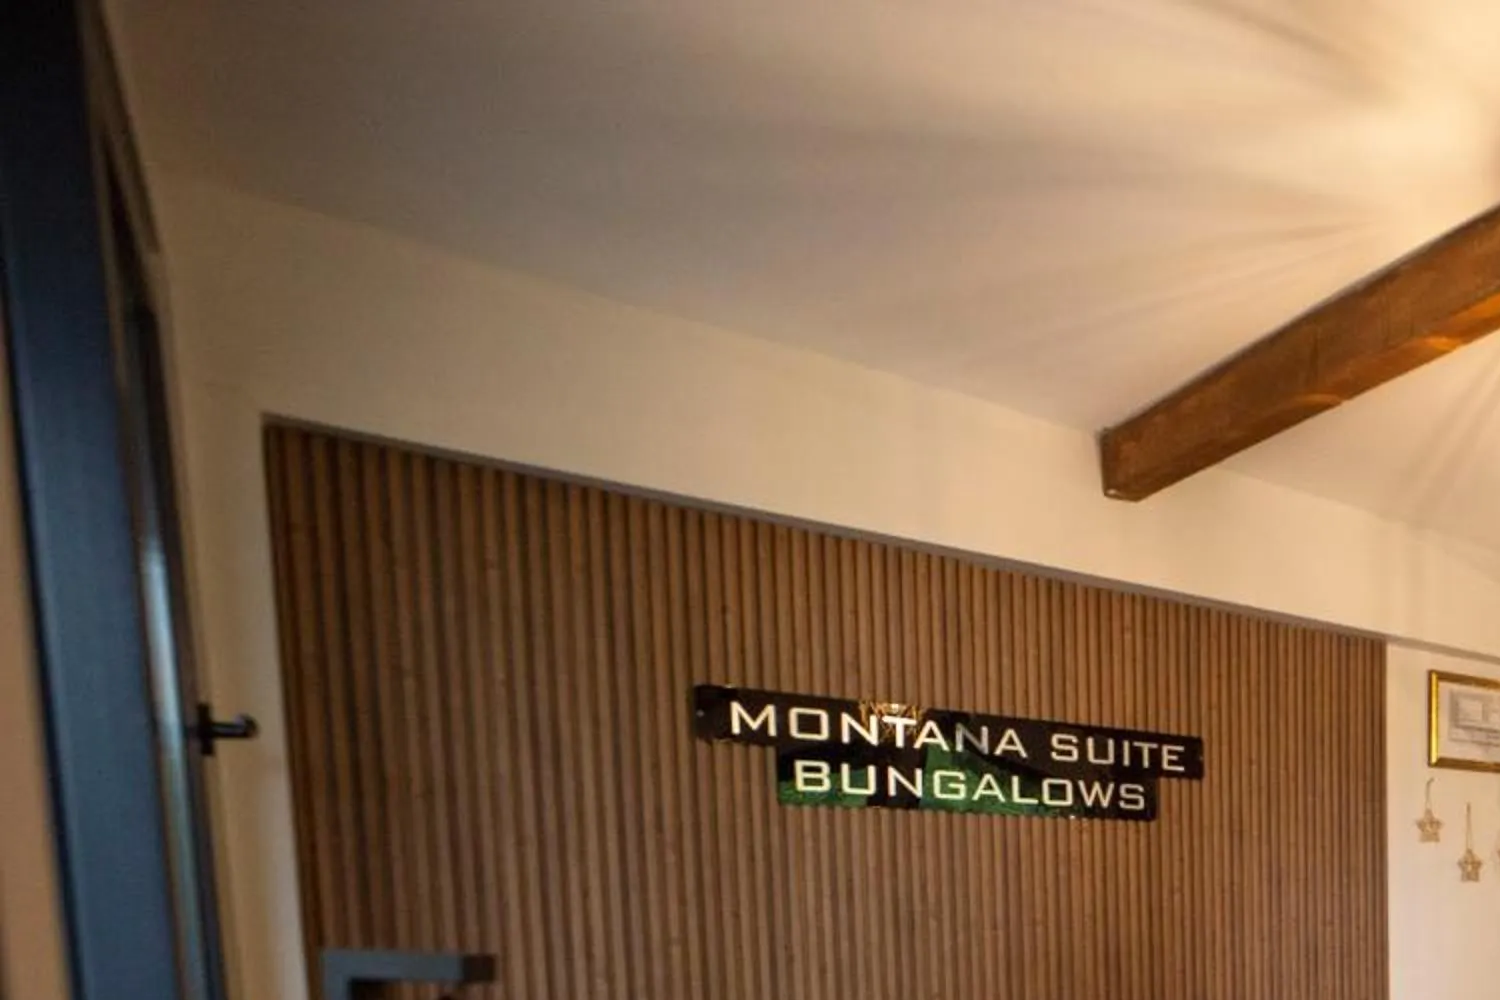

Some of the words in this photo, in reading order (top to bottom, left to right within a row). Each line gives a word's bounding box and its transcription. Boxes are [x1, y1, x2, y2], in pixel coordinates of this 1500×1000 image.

[729, 701, 1028, 758] MONTANA
[1051, 732, 1185, 772] SUITE
[794, 759, 1146, 810] BUNGALOWS
